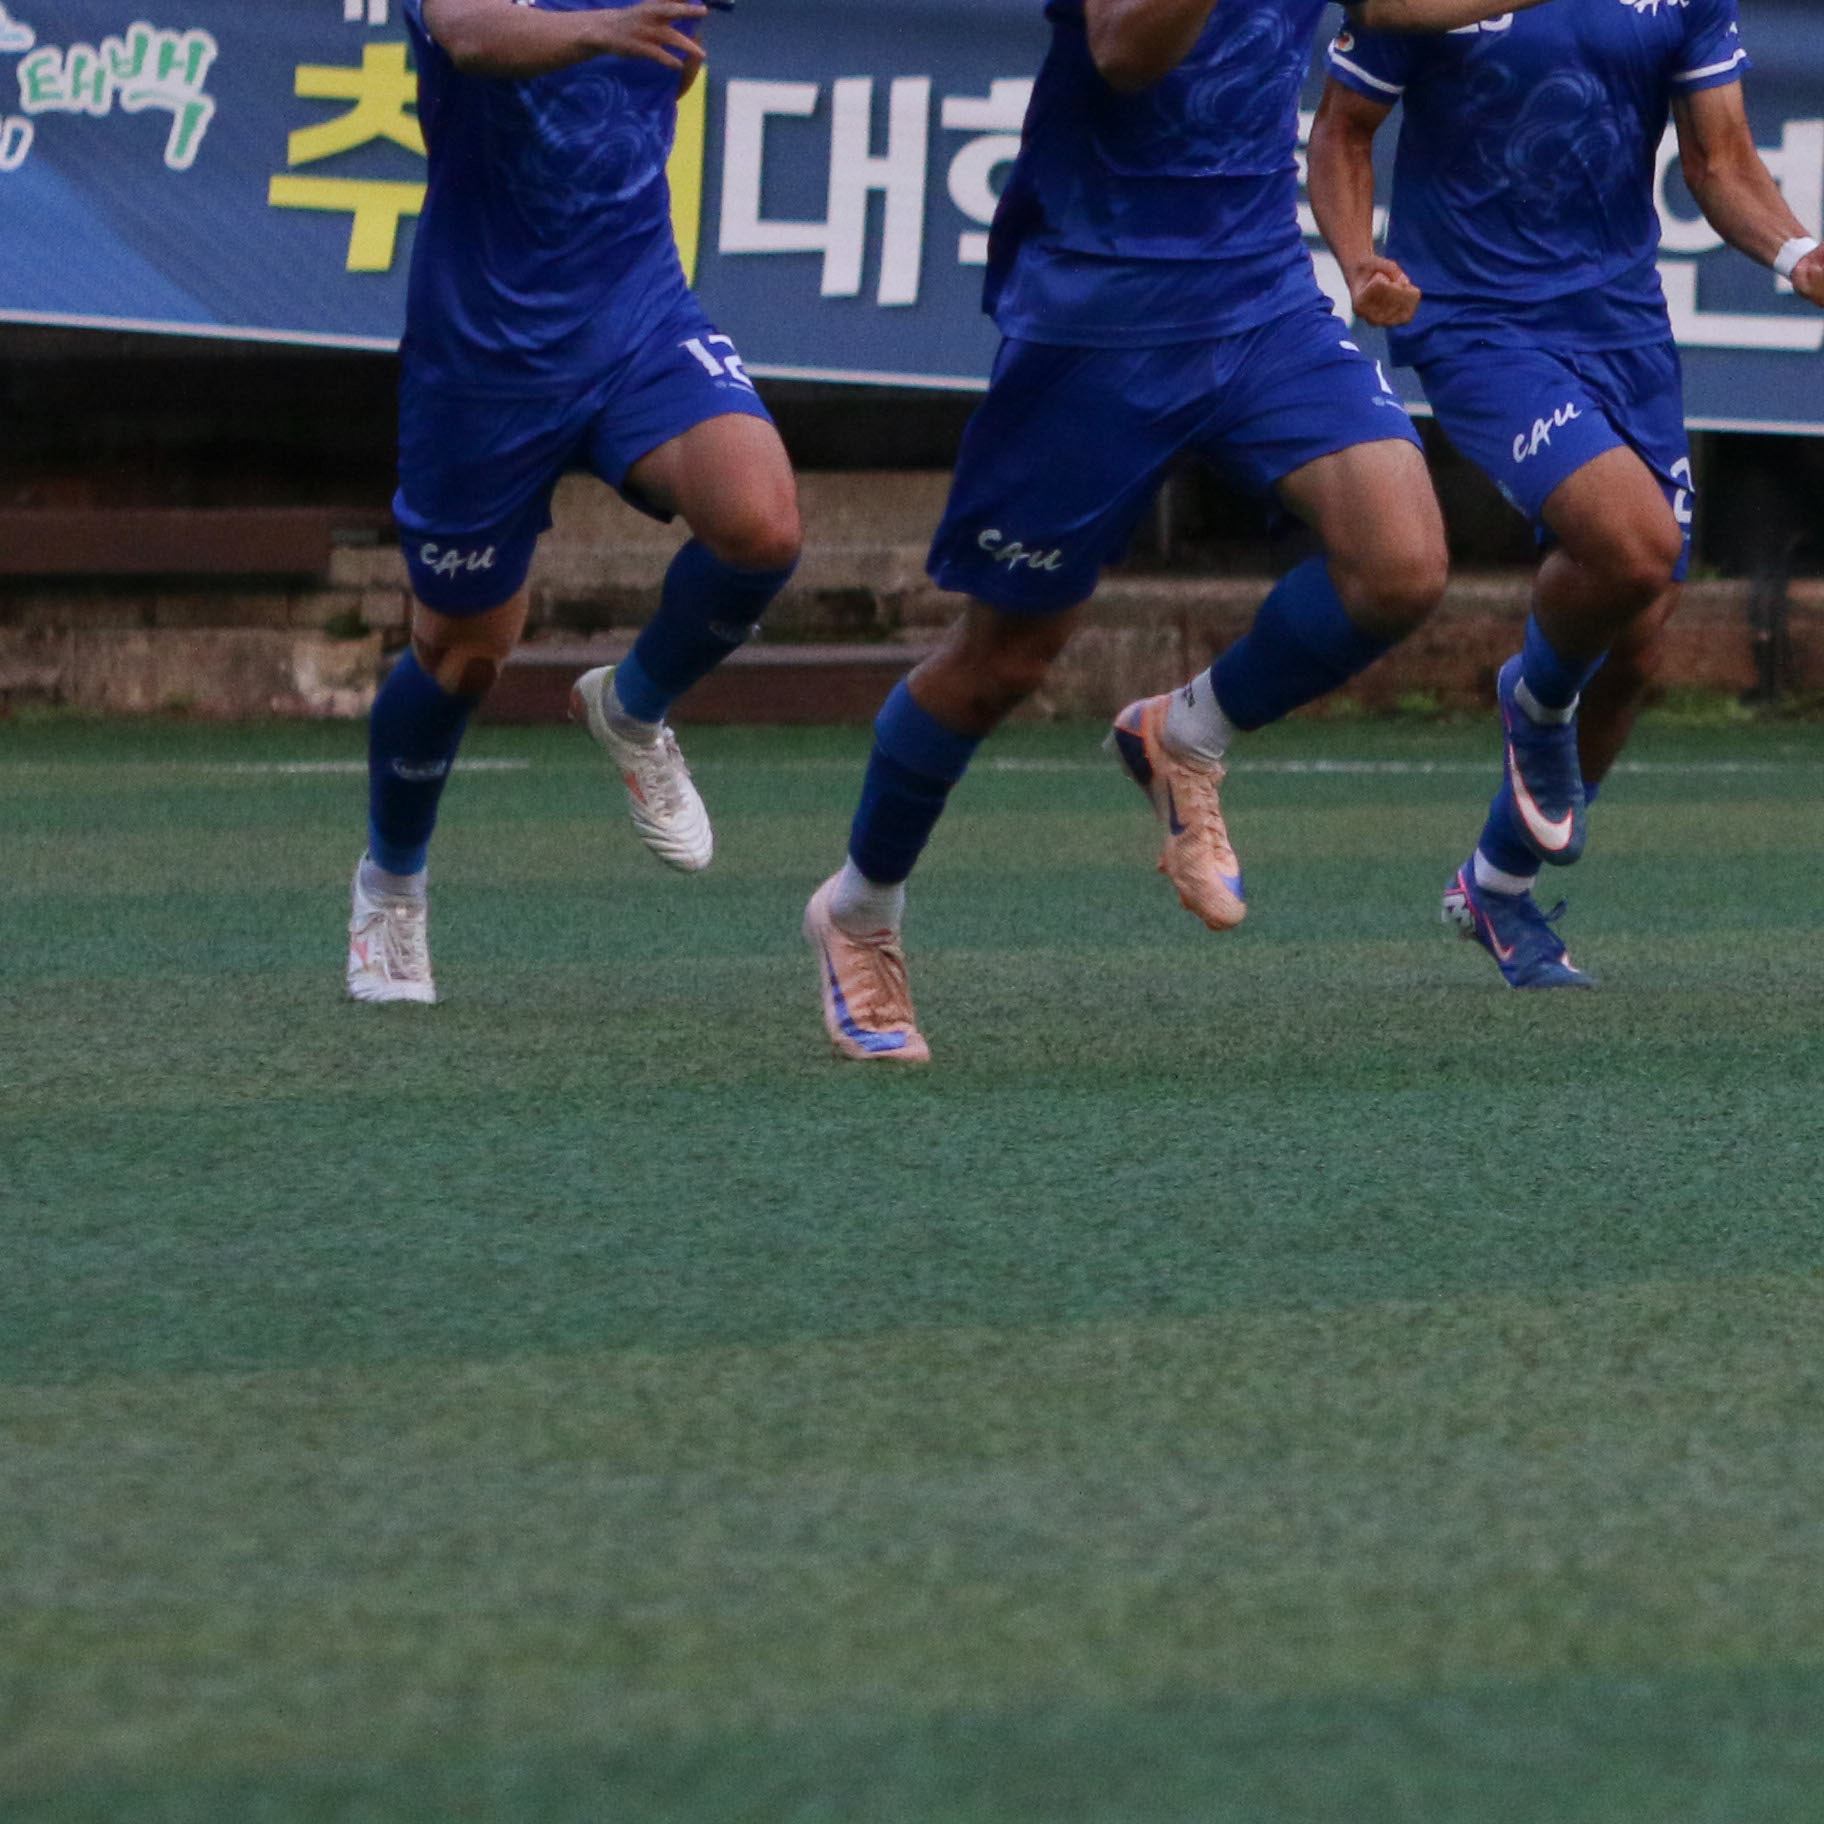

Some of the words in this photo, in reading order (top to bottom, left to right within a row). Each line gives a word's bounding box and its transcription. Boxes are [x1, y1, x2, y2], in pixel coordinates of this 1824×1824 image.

[20, 24, 215, 167] 태백
[1512, 402, 1583, 464] CAU
[420, 542, 496, 578] CAU
